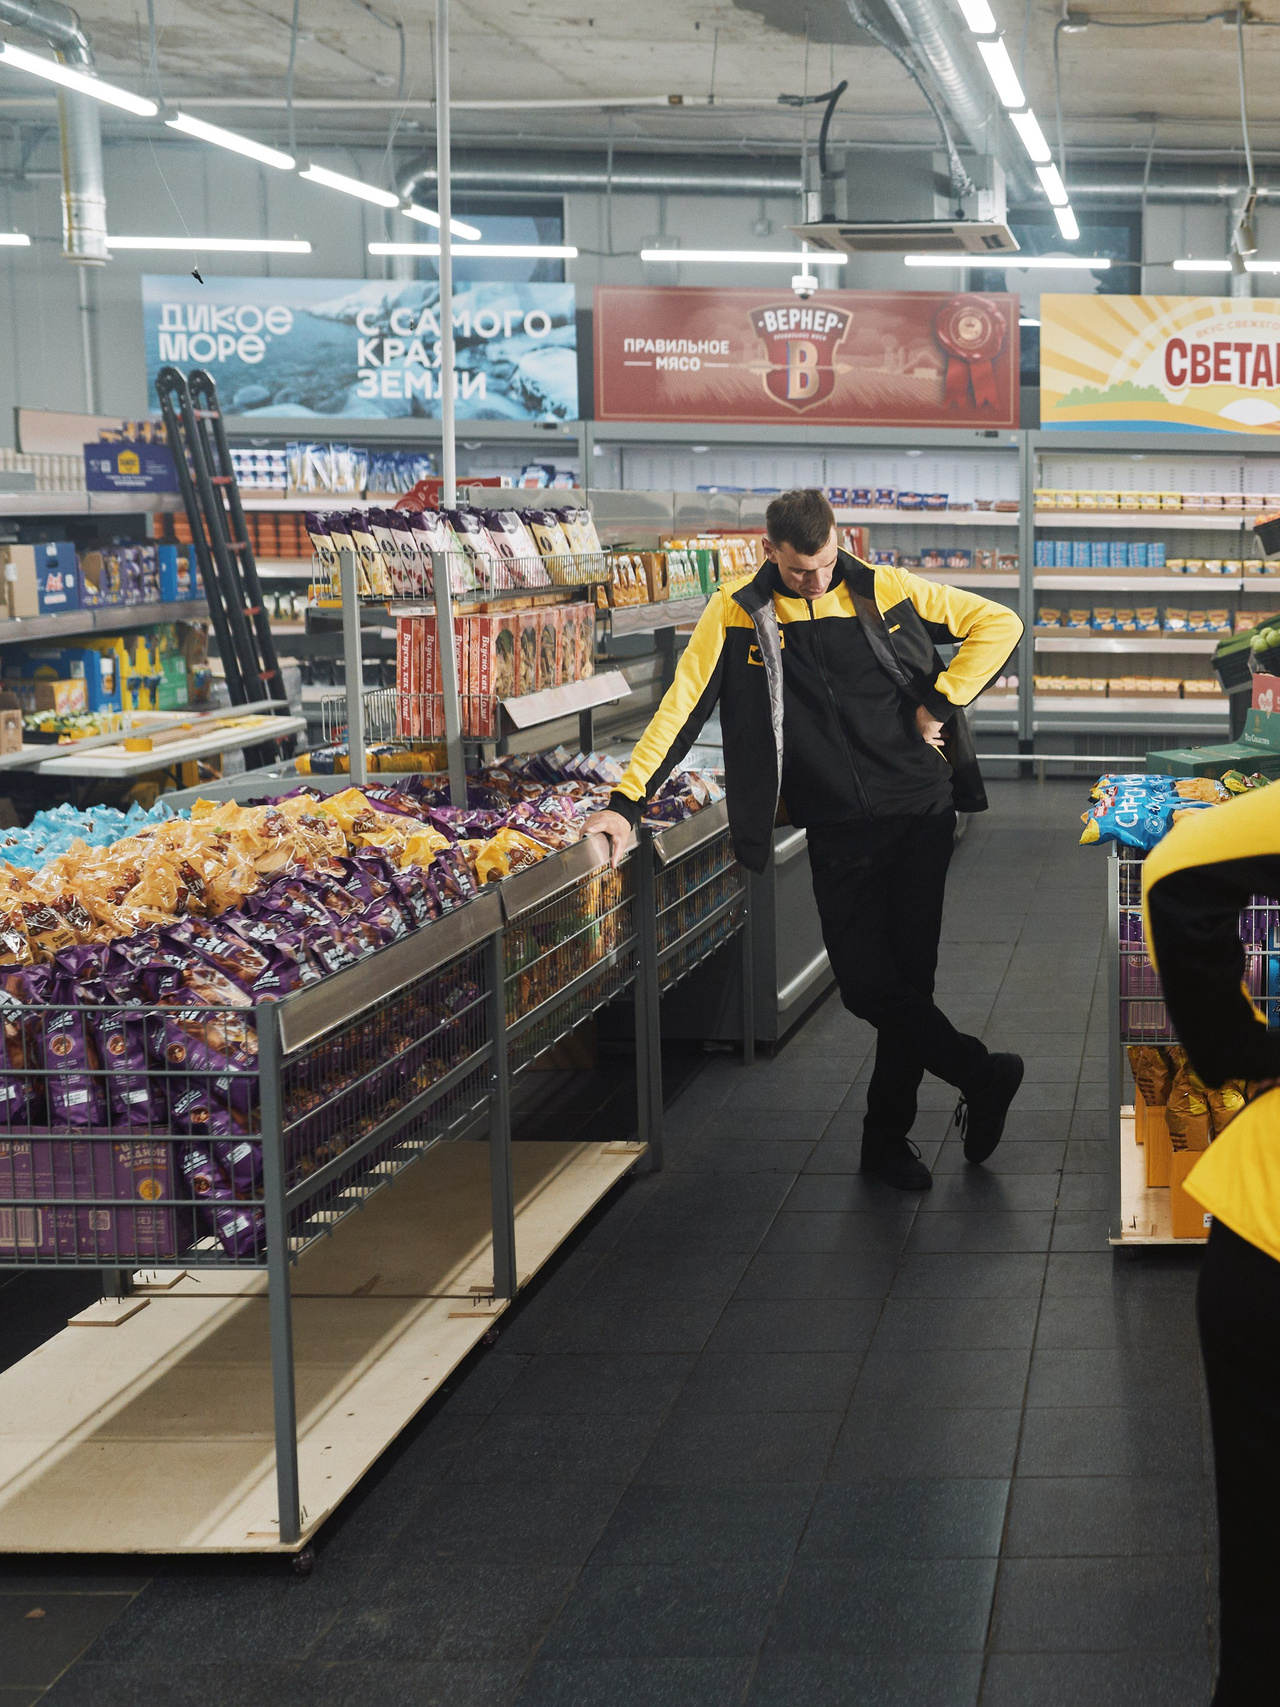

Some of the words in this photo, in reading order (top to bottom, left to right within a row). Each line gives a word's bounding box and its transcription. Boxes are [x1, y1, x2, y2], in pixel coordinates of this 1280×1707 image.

[356, 309, 378, 337] С
[390, 307, 552, 338] САМОГО
[763, 308, 839, 333] ВЕРНЕР
[623, 338, 730, 355] ПРАВИЛЬНОЕ
[656, 356, 701, 371] МЯСО
